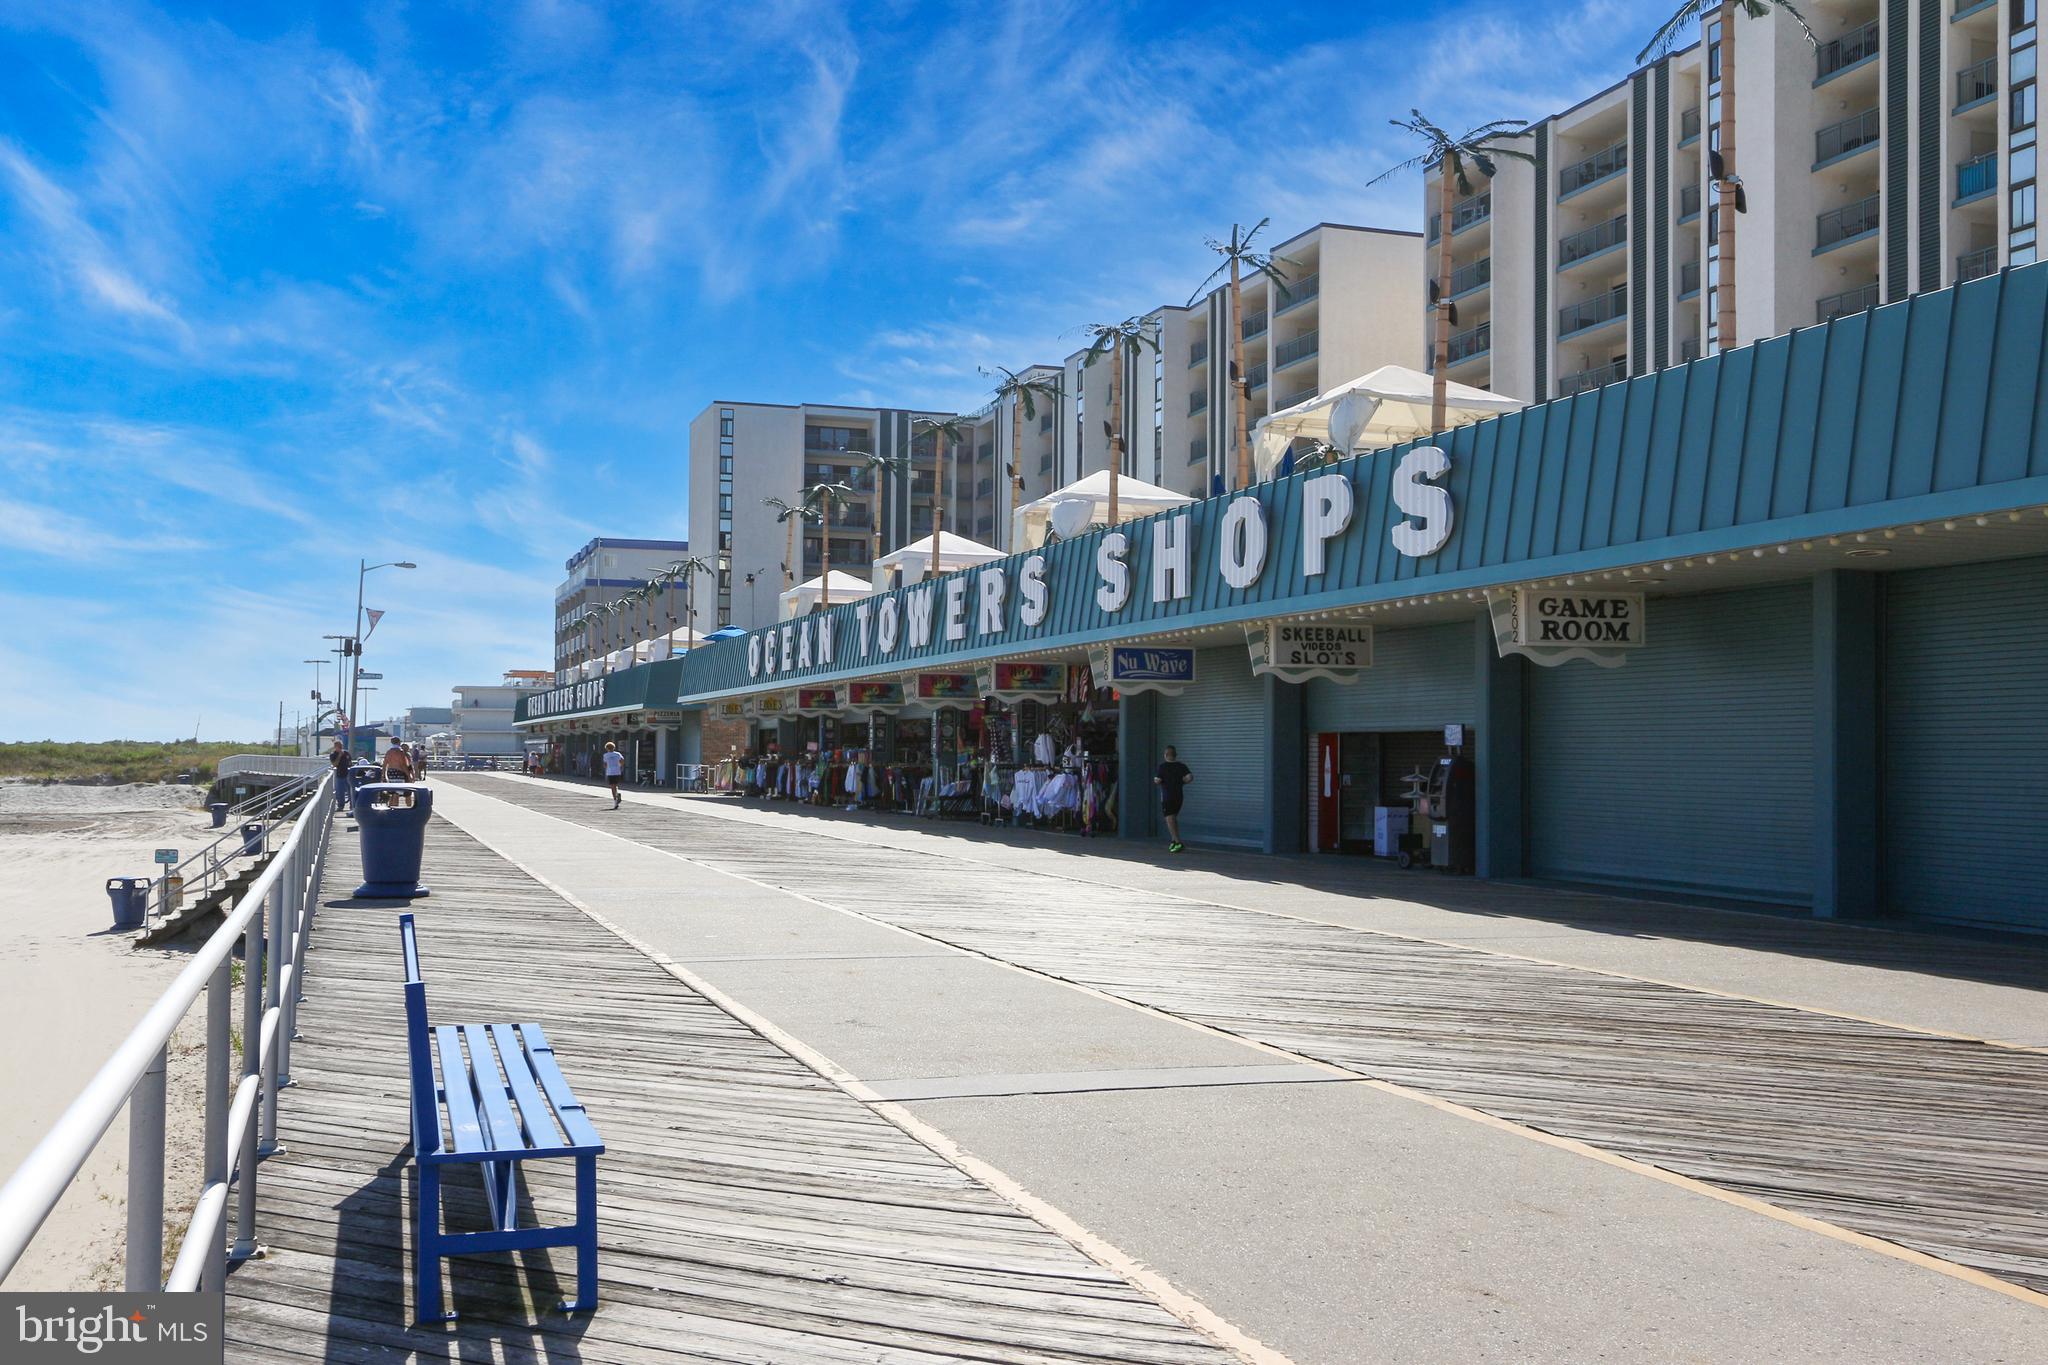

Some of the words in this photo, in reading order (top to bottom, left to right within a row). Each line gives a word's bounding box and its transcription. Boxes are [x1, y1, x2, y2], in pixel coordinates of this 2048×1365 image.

[748, 614, 834, 678] OCEAN
[856, 555, 1049, 657] TOWERS
[1097, 446, 1454, 612] SHOPS
[1538, 597, 1630, 619] GAME
[1282, 627, 1367, 643] SKEEBALL
[1540, 620, 1631, 642] ROOM
[1301, 642, 1342, 651] VIDEOS
[1118, 652, 1138, 672] Nu
[1144, 652, 1187, 673] Wave
[1291, 651, 1356, 665] SLOTS
[577, 679, 604, 709] SHOPS
